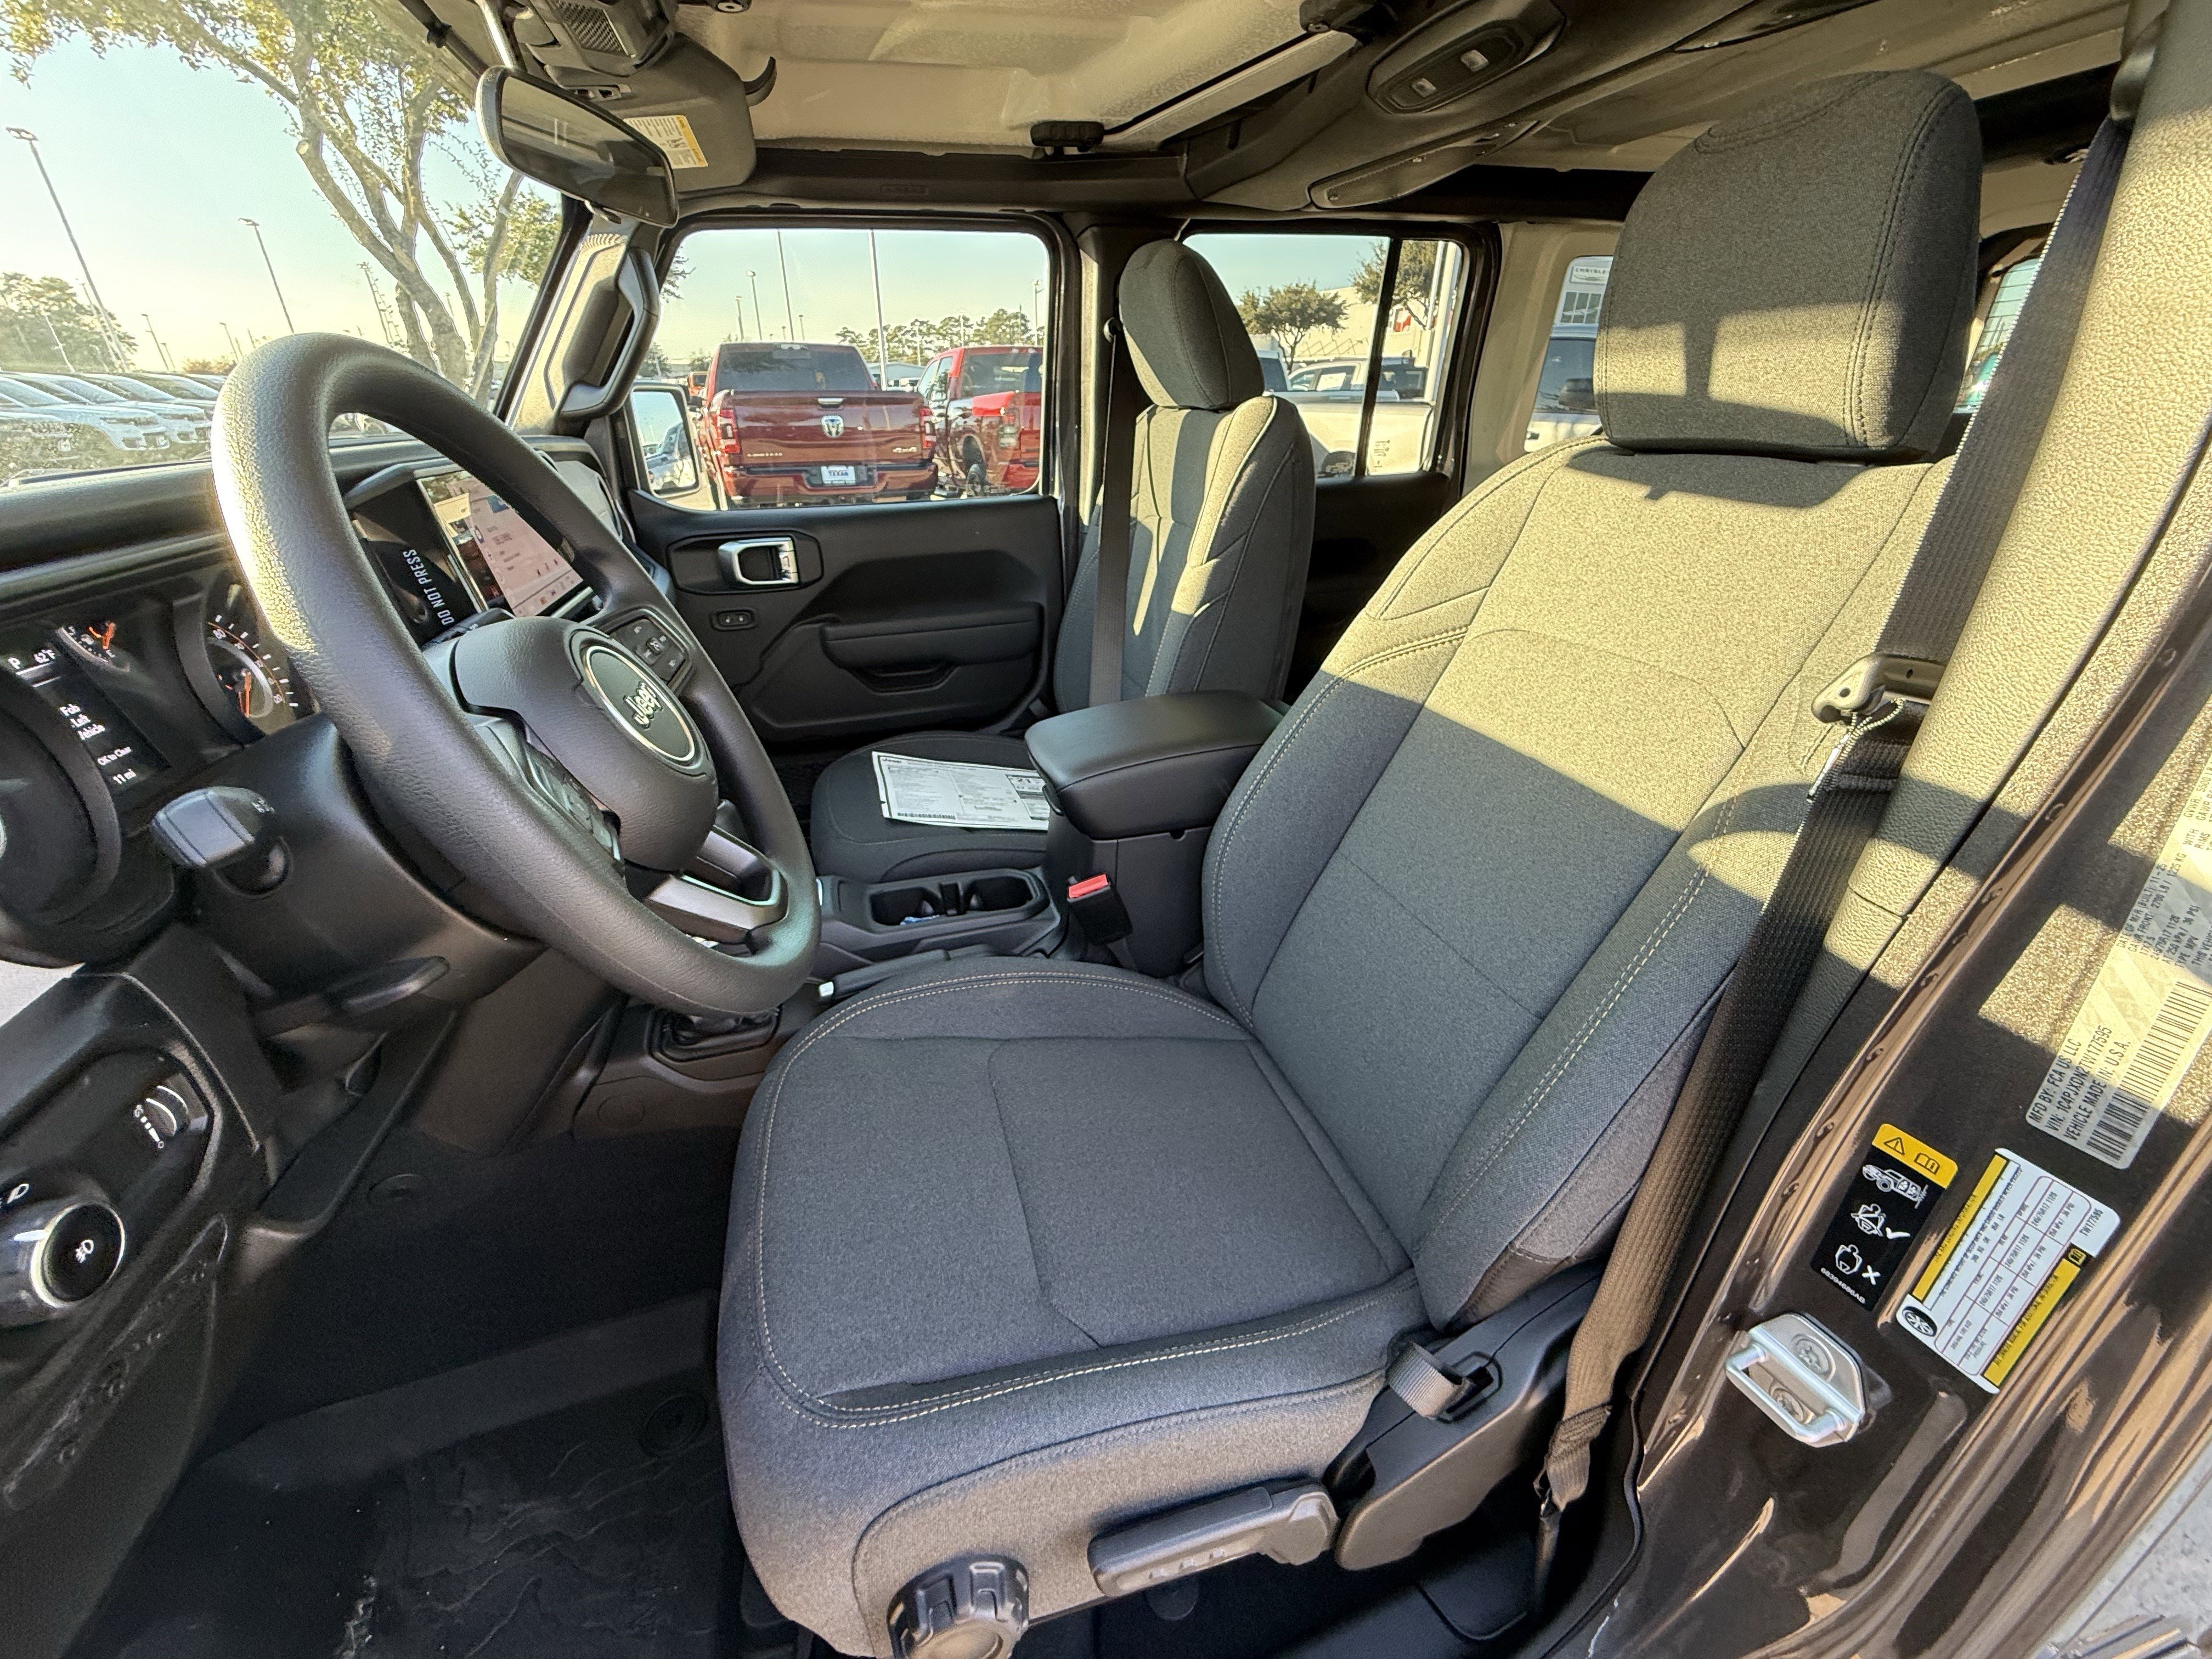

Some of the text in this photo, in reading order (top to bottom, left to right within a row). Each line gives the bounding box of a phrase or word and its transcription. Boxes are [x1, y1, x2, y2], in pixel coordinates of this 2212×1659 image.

[402, 549, 455, 625] DO NOT PRESS
[8, 657, 21, 669] P
[623, 682, 663, 731] Jeep
[2182, 800, 2211, 845] WITH GAWR
[2194, 832, 2211, 849] RIMS
[2175, 853, 2187, 862] KG
[2028, 1038, 2082, 1122] MFD BY: FCA US LLC
[2063, 1041, 2131, 1141] VEHICLE MADE IN: U.S.A.
[2045, 1113, 2066, 1132] VIN:
